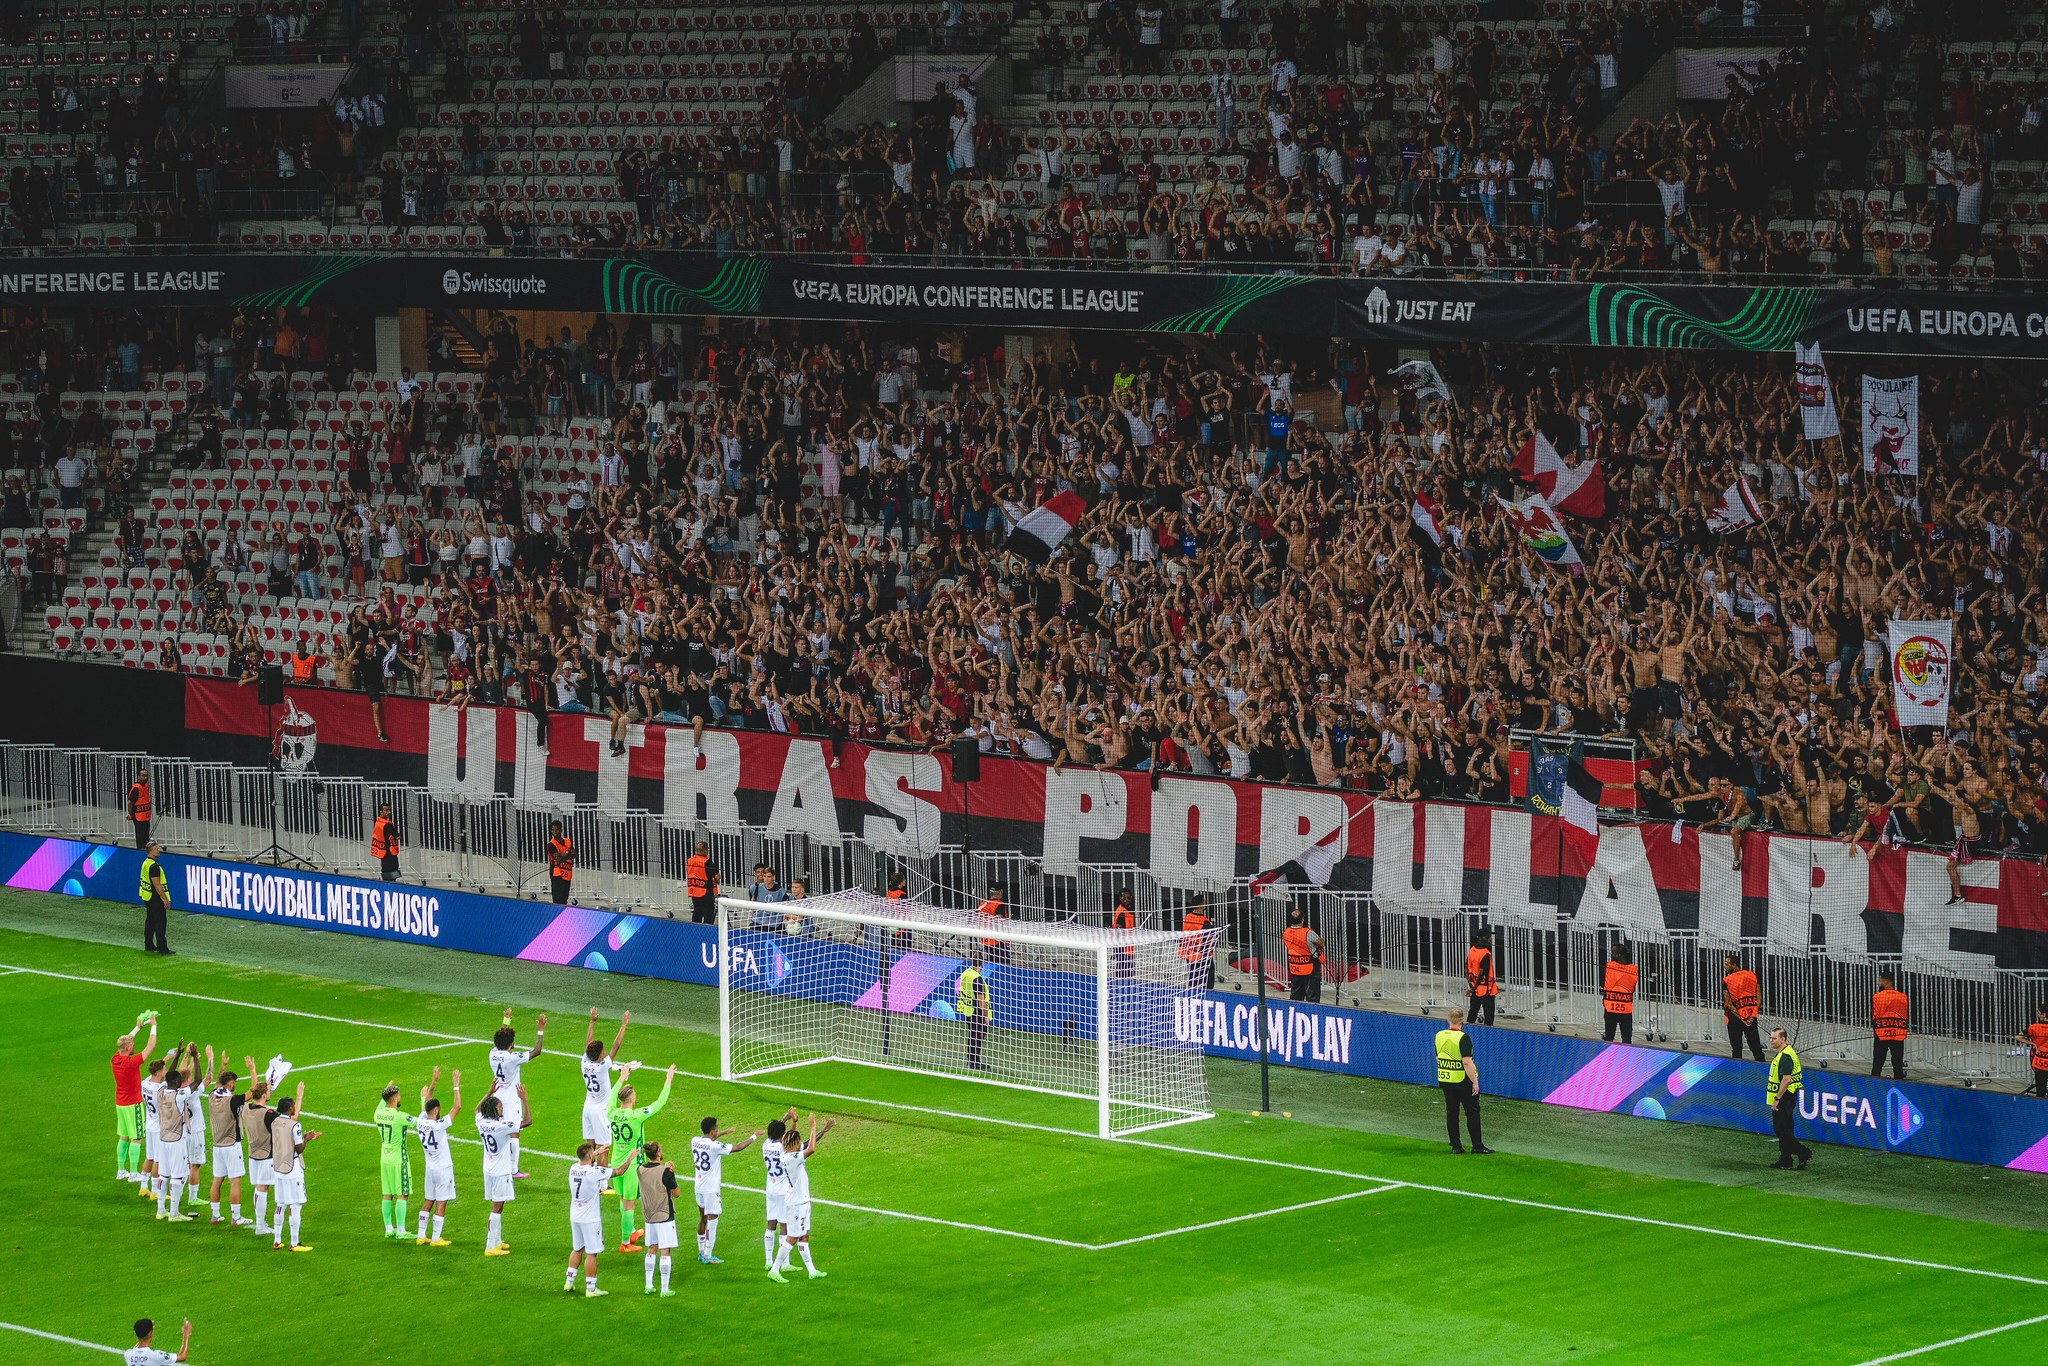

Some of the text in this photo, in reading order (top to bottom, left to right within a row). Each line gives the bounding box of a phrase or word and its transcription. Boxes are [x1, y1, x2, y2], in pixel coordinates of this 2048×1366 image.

[0, 272, 125, 293] NFERENCE
[462, 271, 546, 298] Swissquote
[792, 279, 842, 303] UEFA
[846, 283, 919, 307] EUROPA
[923, 285, 1054, 310] CONFERENCE
[1395, 300, 1476, 323] JUST EAT
[1847, 308, 2048, 338] UEFA EUROPA C
[1867, 380, 1913, 394] POPULAIRE
[427, 703, 2001, 985] ULTRAS POPULAIRE
[186, 864, 439, 938] WHERE FOOTBALL MEETS MUSIC
[1611, 1003, 1626, 1012] 125
[496, 1063, 505, 1082] 4
[583, 1073, 600, 1093] 25
[1798, 1088, 1877, 1129] UEFA
[377, 1123, 392, 1144] 77
[418, 1129, 439, 1150] 24
[610, 1121, 634, 1142] 90
[480, 1133, 498, 1153] 19
[692, 1148, 711, 1172] 28
[764, 1156, 784, 1177] 23
[573, 1177, 583, 1199] 7
